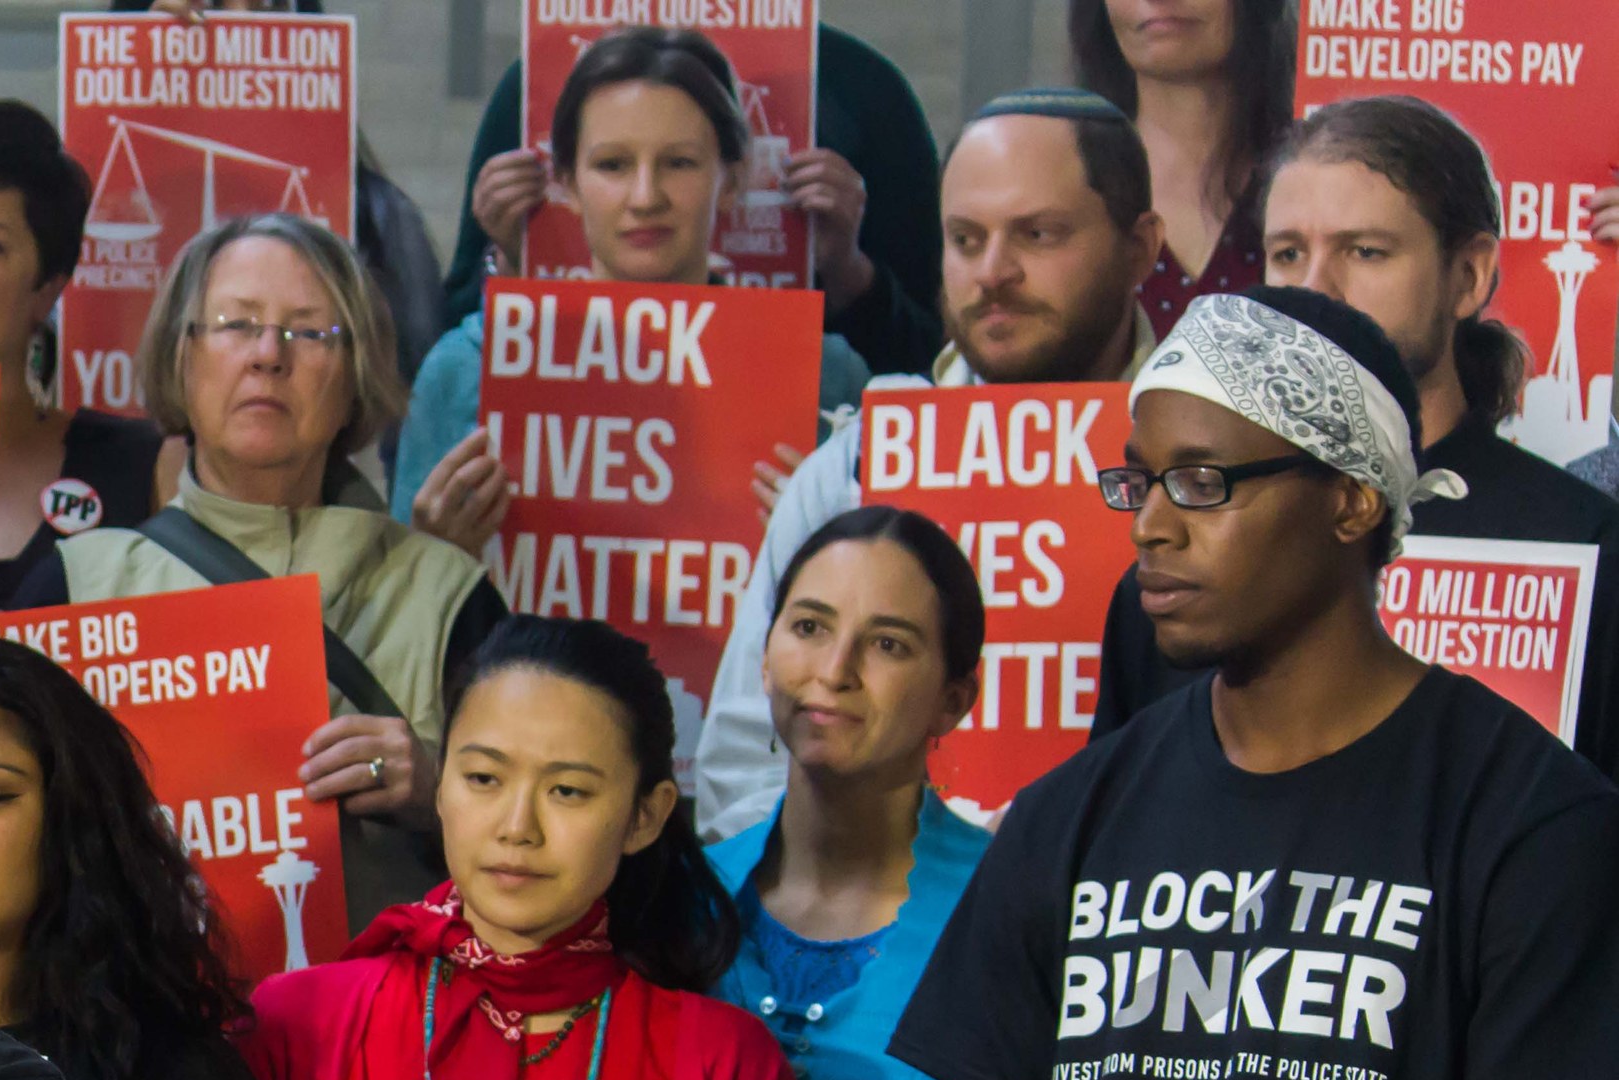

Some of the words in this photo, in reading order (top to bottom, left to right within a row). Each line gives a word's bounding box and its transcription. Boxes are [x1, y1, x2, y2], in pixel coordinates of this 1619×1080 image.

[537, 0, 651, 25] DOLLAR
[658, 0, 802, 29] QUESTION
[1308, 0, 1402, 30] MAKE
[1411, 0, 1465, 33] BIG
[75, 26, 135, 65] THE
[149, 26, 207, 66] 160
[215, 27, 340, 68] MILLION
[1305, 35, 1514, 84] DEVELOPERS
[1521, 42, 1585, 86] PAY
[74, 68, 190, 106] DOLLAR
[197, 69, 342, 111] QUESTION
[488, 291, 715, 388] BLACK
[72, 349, 146, 409] YO
[868, 397, 1104, 491] BLACK
[48, 489, 97, 522] TPP
[484, 531, 754, 628] MATTER
[1417, 568, 1565, 623] MILLION
[78, 610, 140, 660] BIG
[1393, 617, 1558, 671] QUESTION
[82, 654, 198, 708] OPERS
[205, 644, 272, 696] PAY
[955, 641, 1103, 731] TTE
[1068, 868, 1277, 942] BLOCK
[1288, 869, 1433, 951] THE
[1056, 945, 1407, 1051] BUNKER
[1141, 1055, 1221, 1080] PRISONS
[1237, 1051, 1272, 1077] THE
